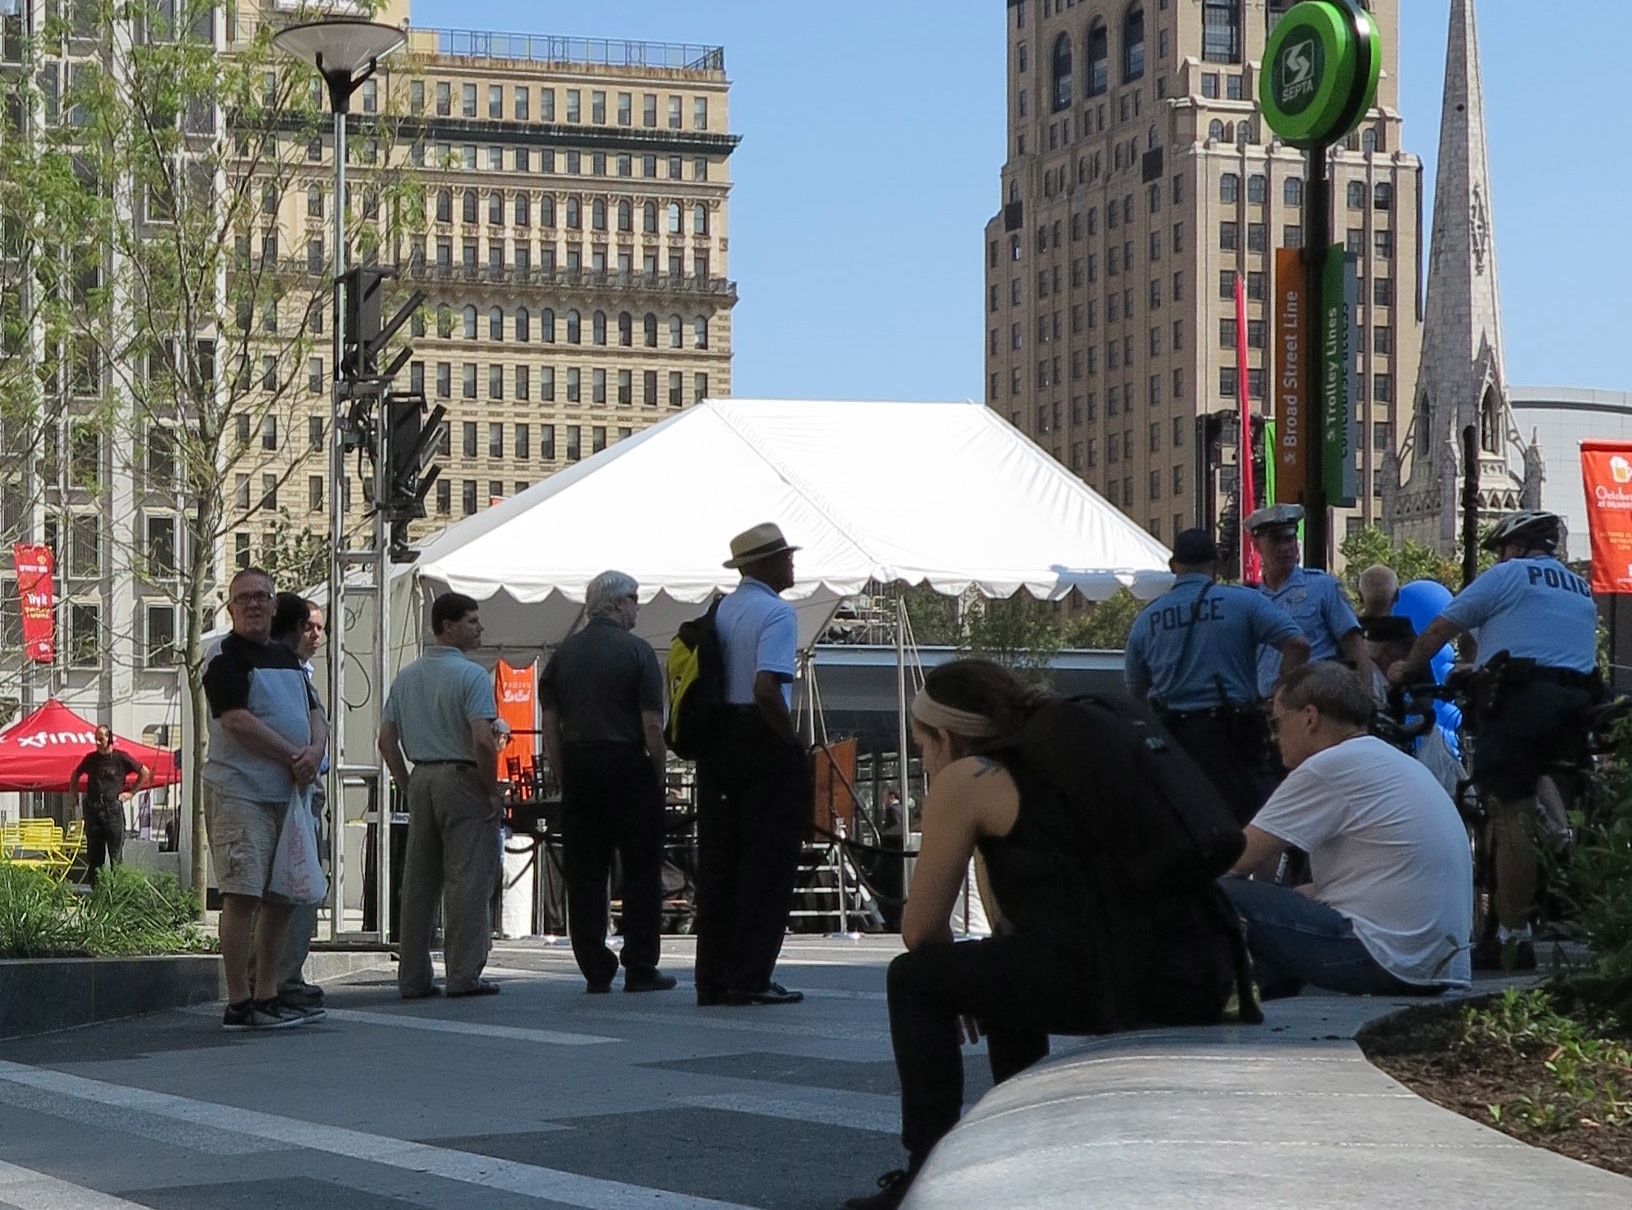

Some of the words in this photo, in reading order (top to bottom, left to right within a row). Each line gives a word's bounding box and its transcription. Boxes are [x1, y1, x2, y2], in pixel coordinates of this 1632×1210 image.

[1281, 79, 1314, 103] SEPTA
[1283, 290, 1299, 328] Line
[1326, 307, 1338, 357] Lines
[1283, 334, 1298, 389] Street
[1325, 360, 1339, 426] Trolley
[1282, 394, 1298, 447] Broad
[1150, 596, 1225, 637] POLICE
[18, 731, 120, 748] xfinit
